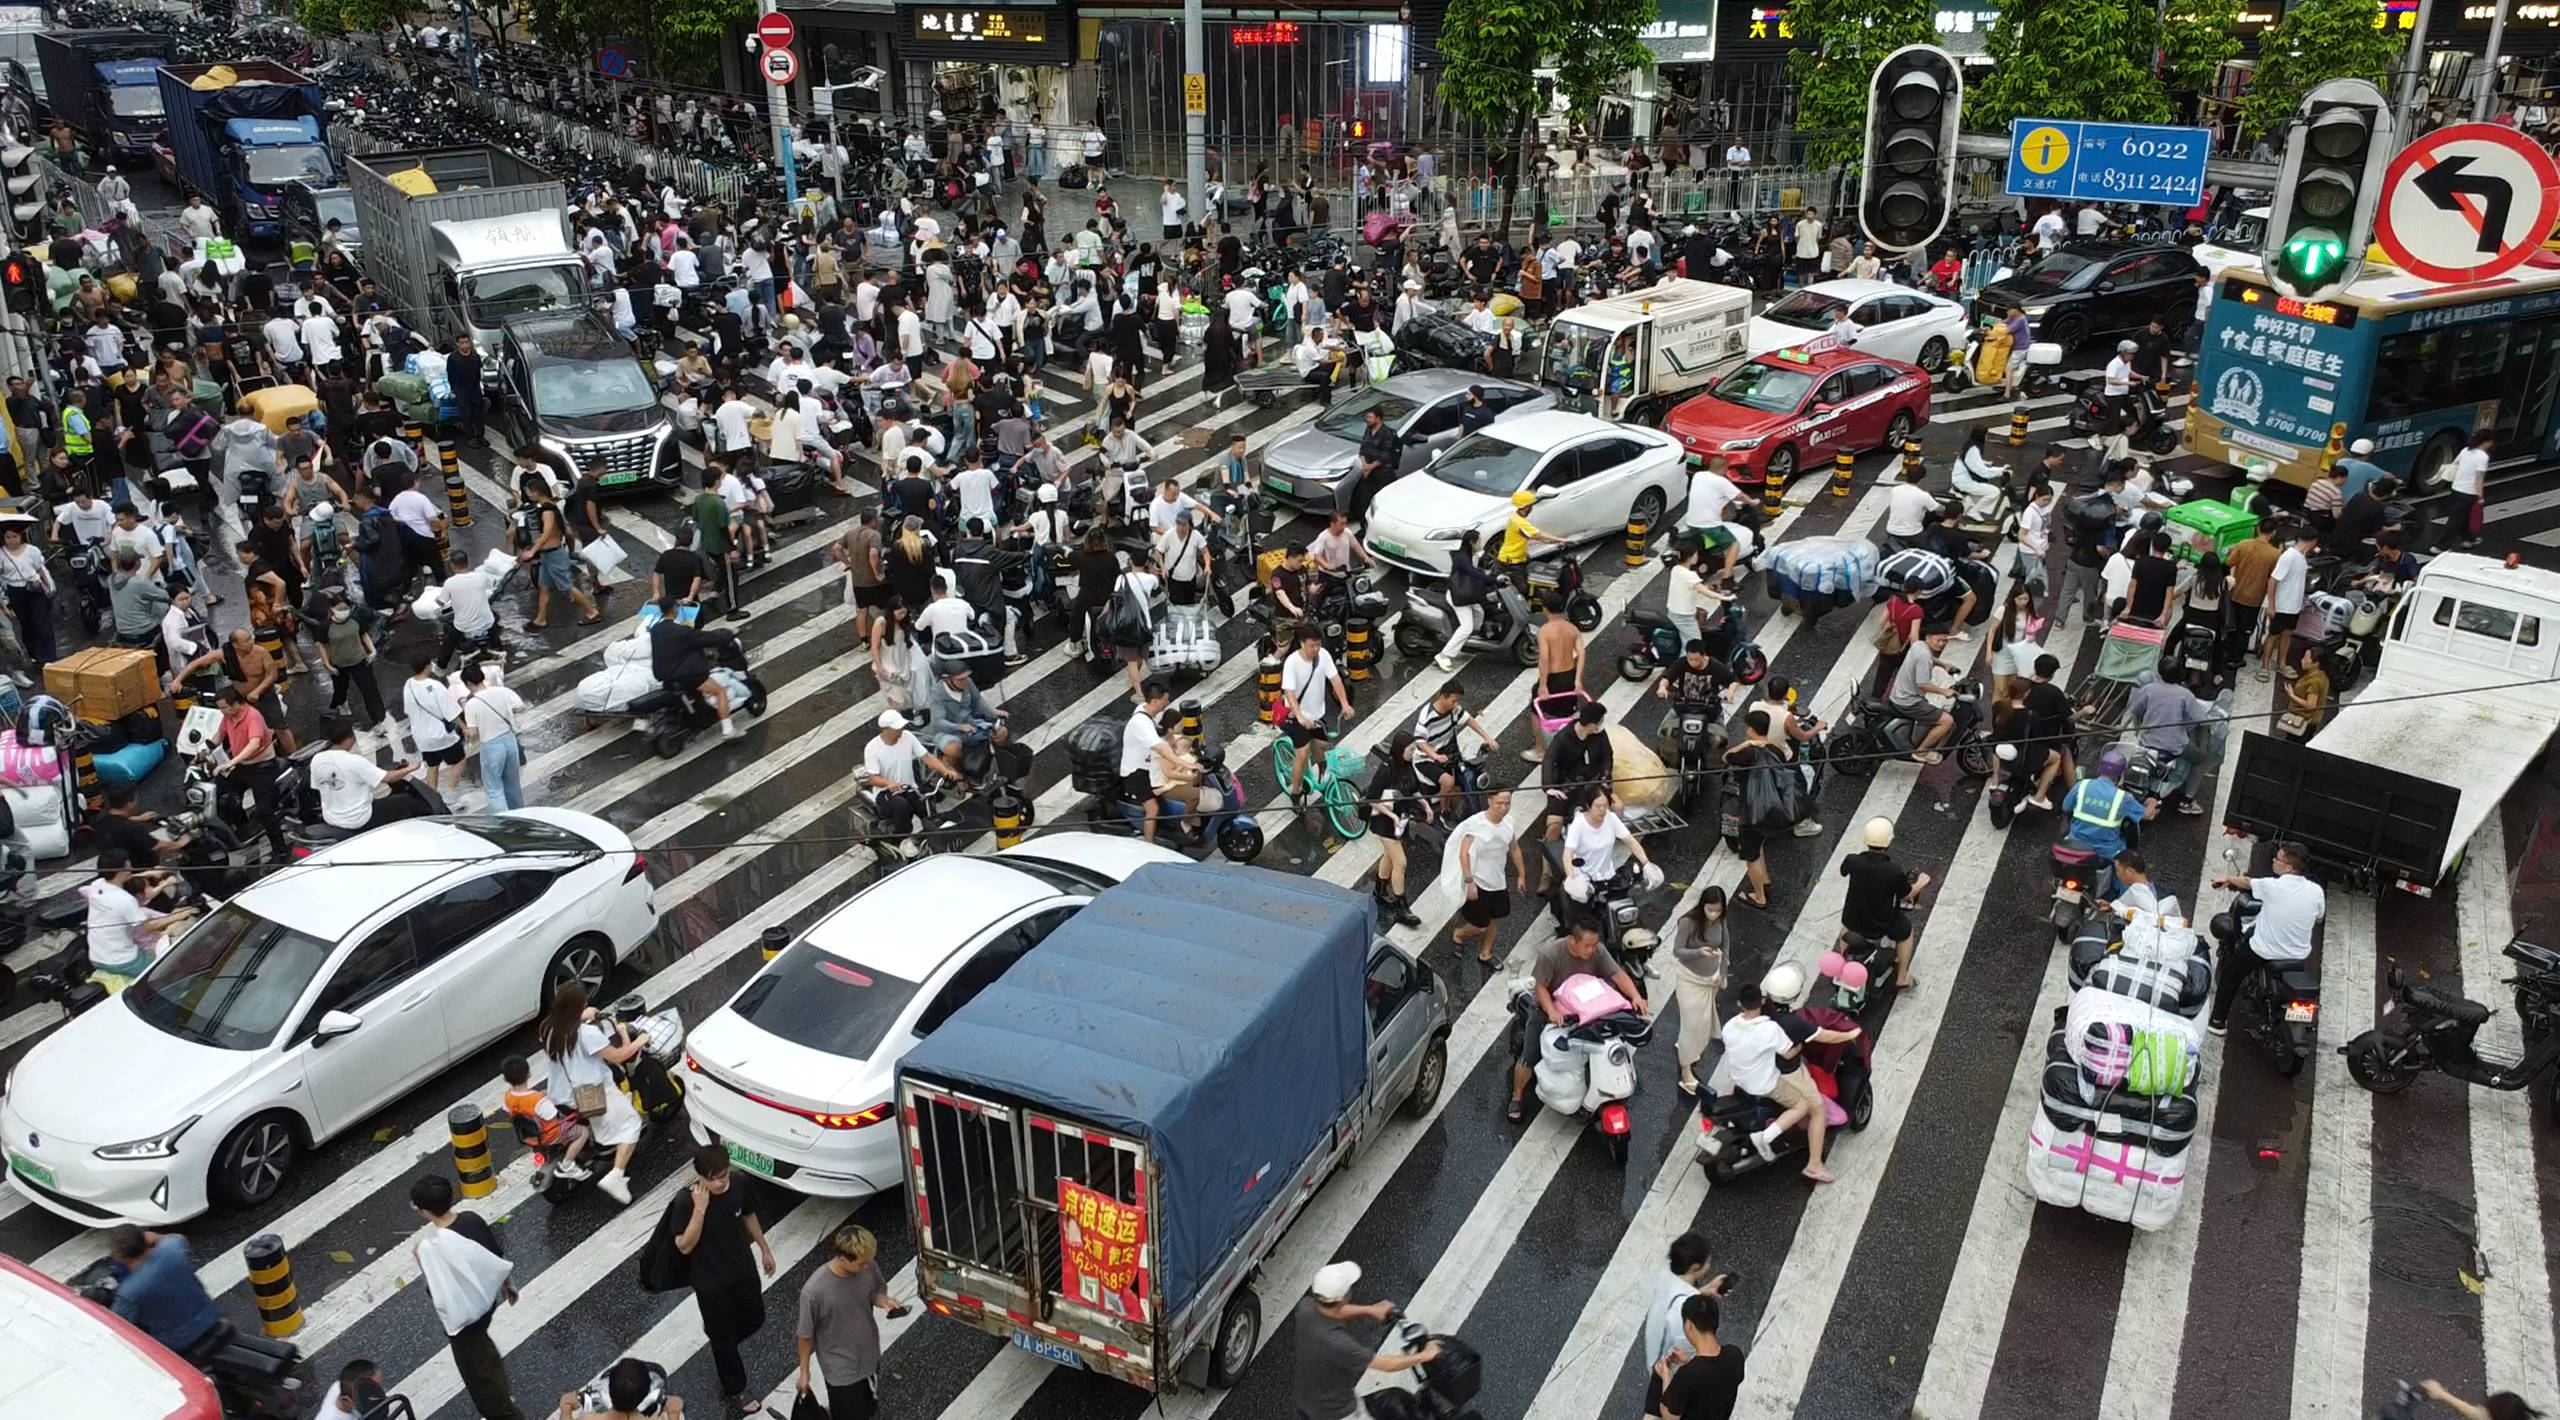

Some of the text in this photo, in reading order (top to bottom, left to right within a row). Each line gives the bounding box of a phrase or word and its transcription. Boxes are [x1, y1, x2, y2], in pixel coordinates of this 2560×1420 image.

[2122, 136, 2188, 160] 6022
[2023, 178, 2057, 189] 交通灯
[2078, 168, 2197, 197] 电话 8311 2424
[2220, 326, 2344, 378] 中家医家庭医生
[2265, 416, 2327, 443] 8700 8700
